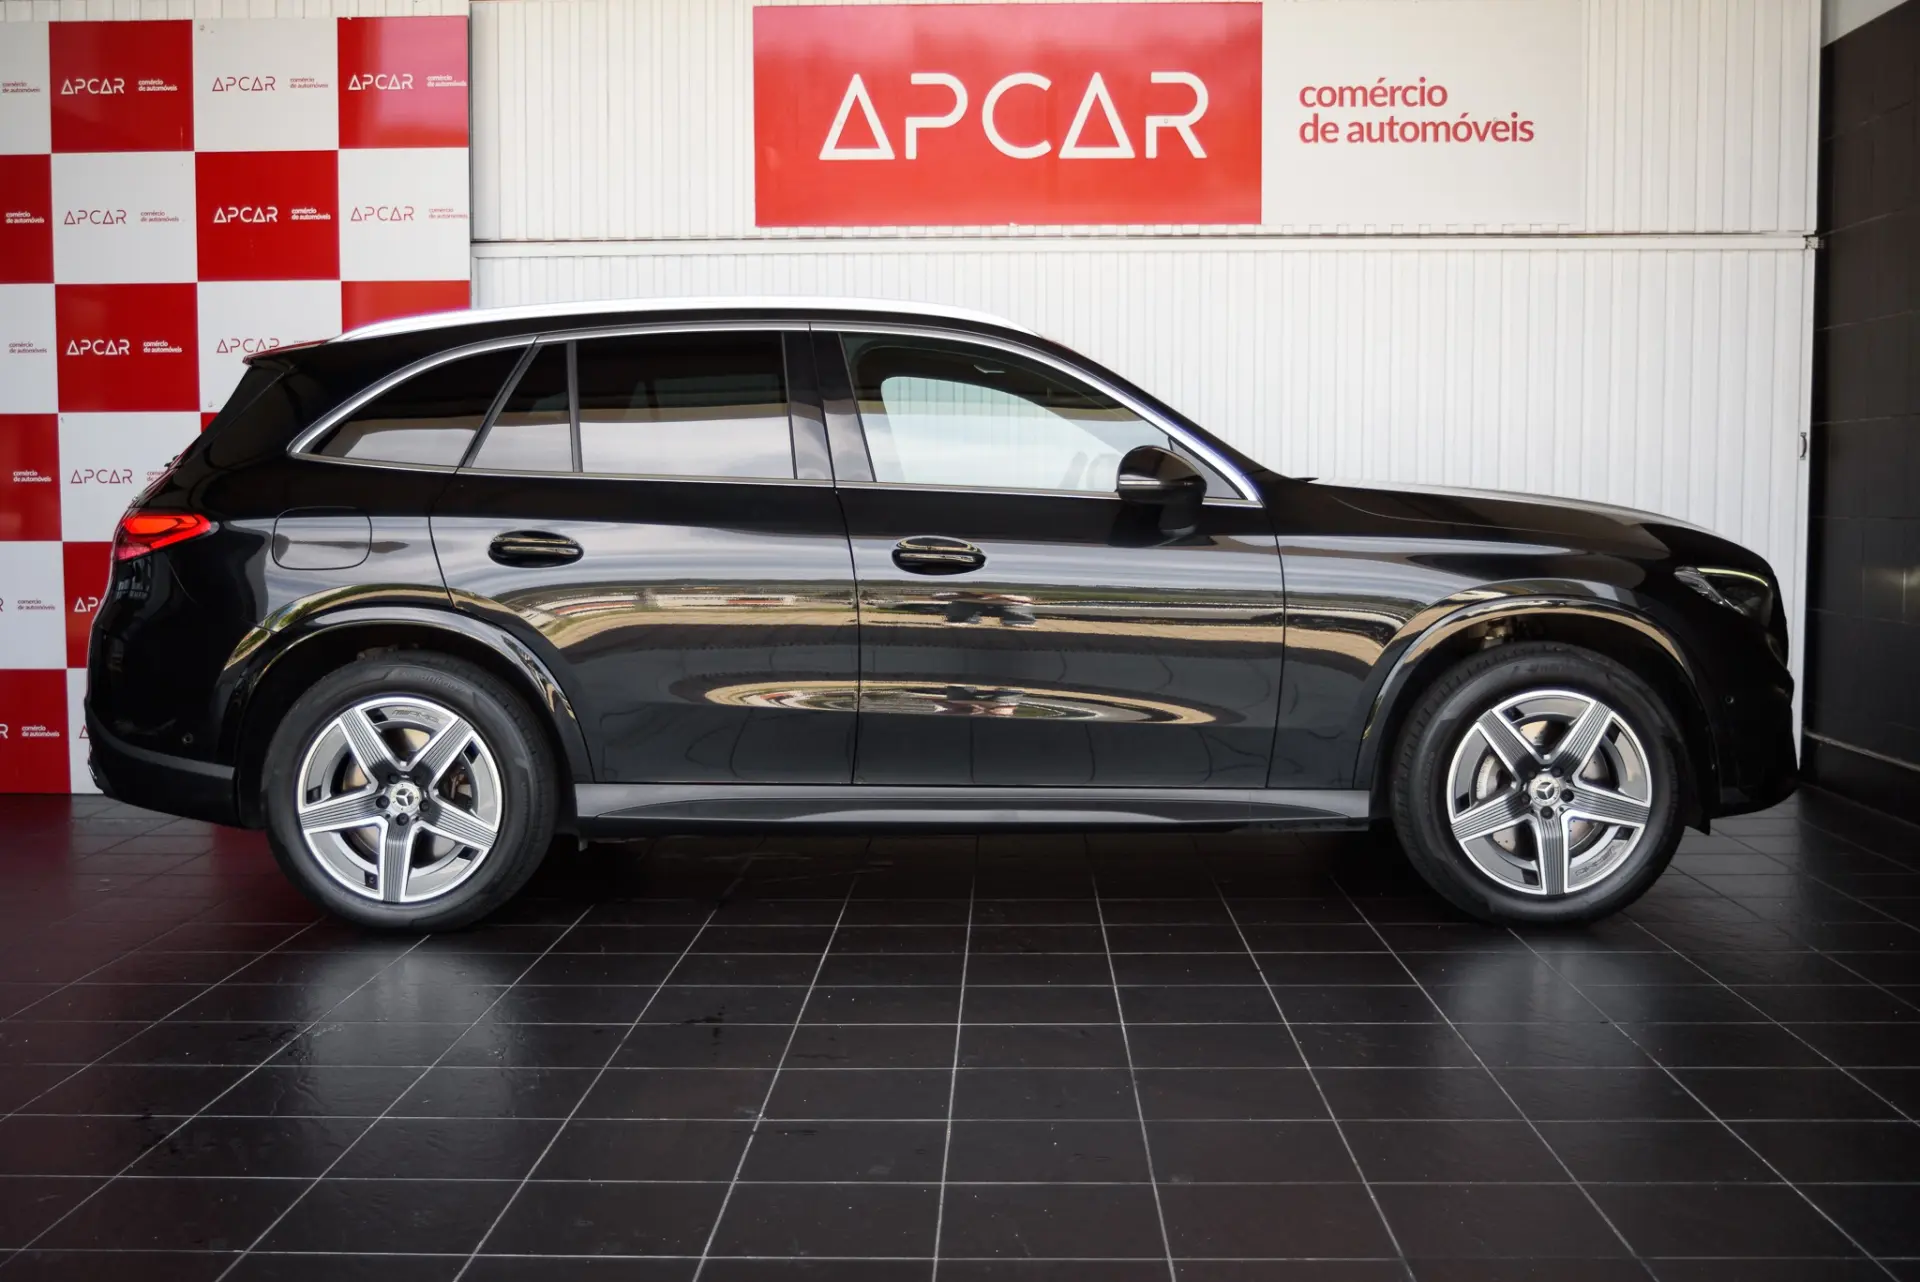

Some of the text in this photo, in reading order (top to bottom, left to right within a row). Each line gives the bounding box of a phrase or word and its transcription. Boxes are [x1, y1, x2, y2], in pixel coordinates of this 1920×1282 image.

[60, 78, 125, 95] APCAR
[211, 76, 276, 92] APCAR
[348, 74, 414, 90] APCAR
[1299, 76, 1448, 109] comércio
[818, 71, 1208, 161] APCAR
[1299, 111, 1535, 144] de automóveis
[63, 209, 127, 225] APCAR
[213, 206, 278, 223] APCAR
[350, 206, 414, 221] APCAR
[65, 339, 130, 356] APCAR
[70, 469, 133, 484] APCAR
